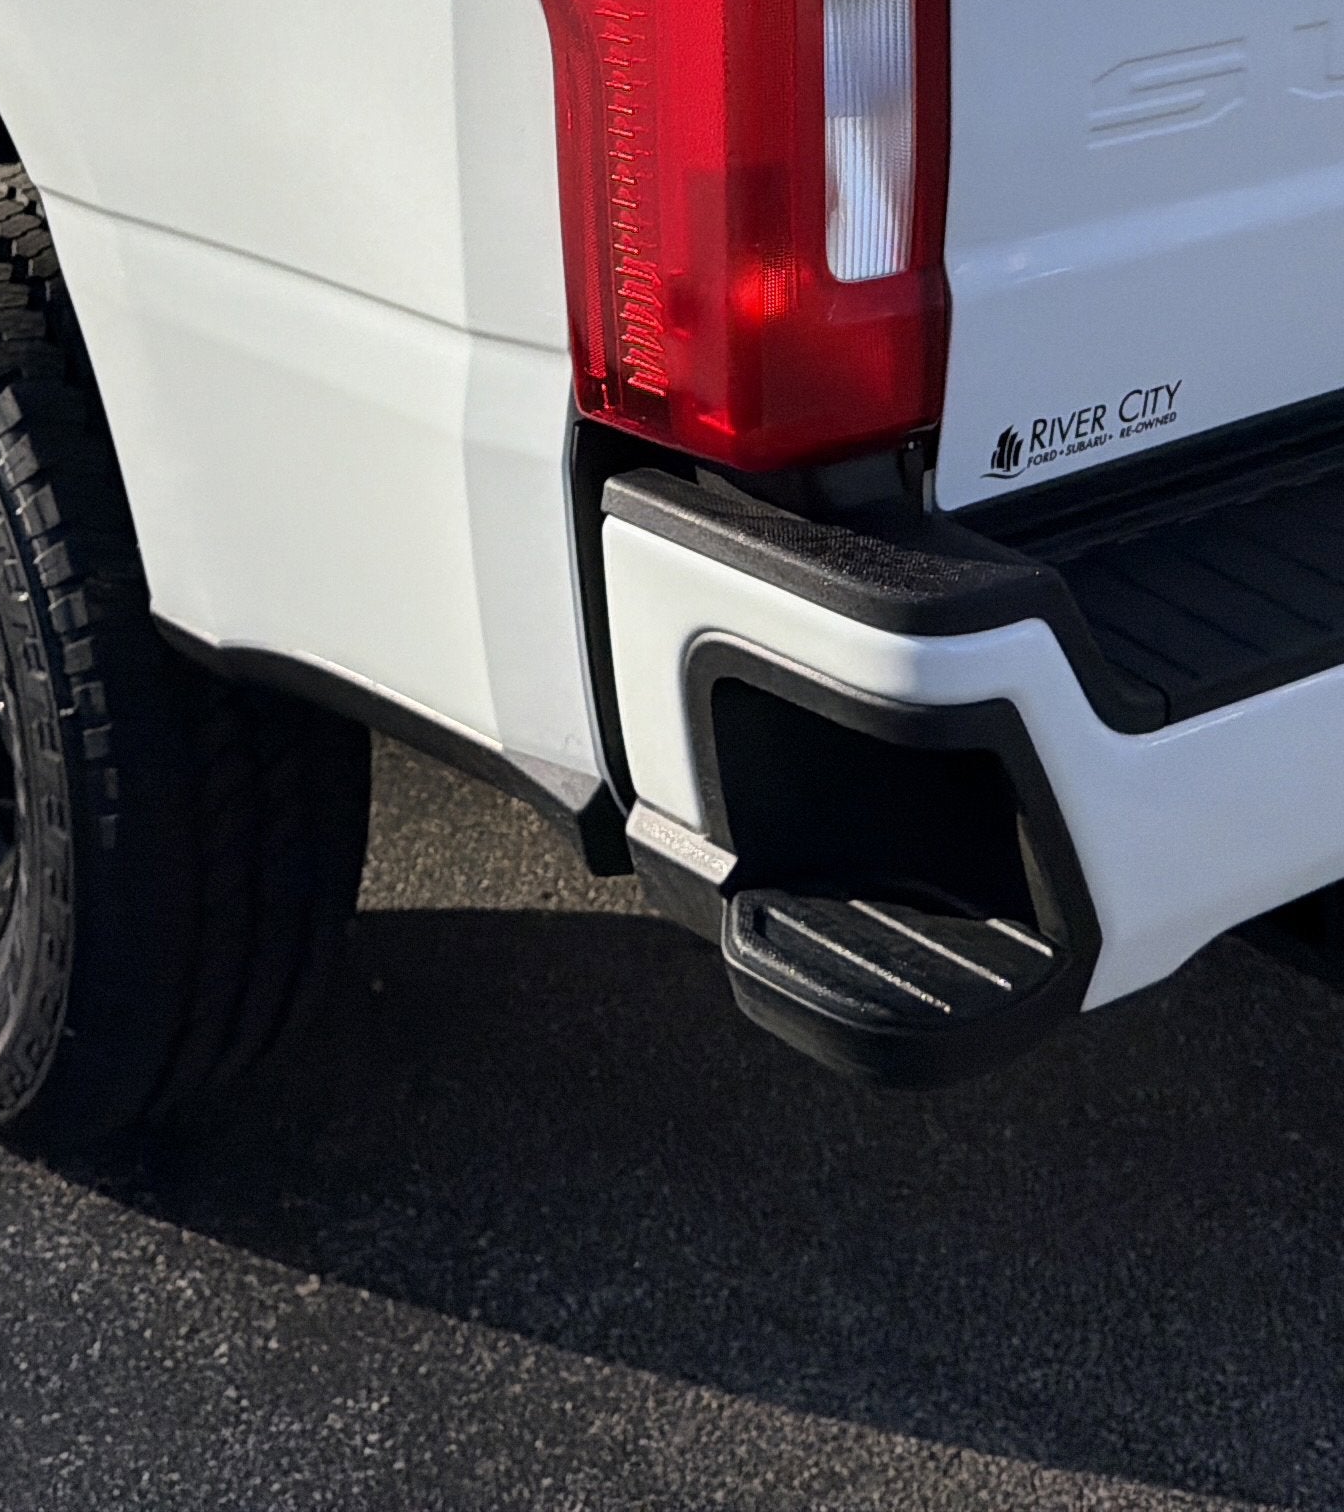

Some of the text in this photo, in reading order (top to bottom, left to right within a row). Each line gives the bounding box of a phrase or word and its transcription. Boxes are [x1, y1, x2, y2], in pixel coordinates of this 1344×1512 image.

[1028, 379, 1183, 453] RIVER CITY
[1026, 445, 1058, 469] FORD
[1064, 432, 1107, 457] SUBARU
